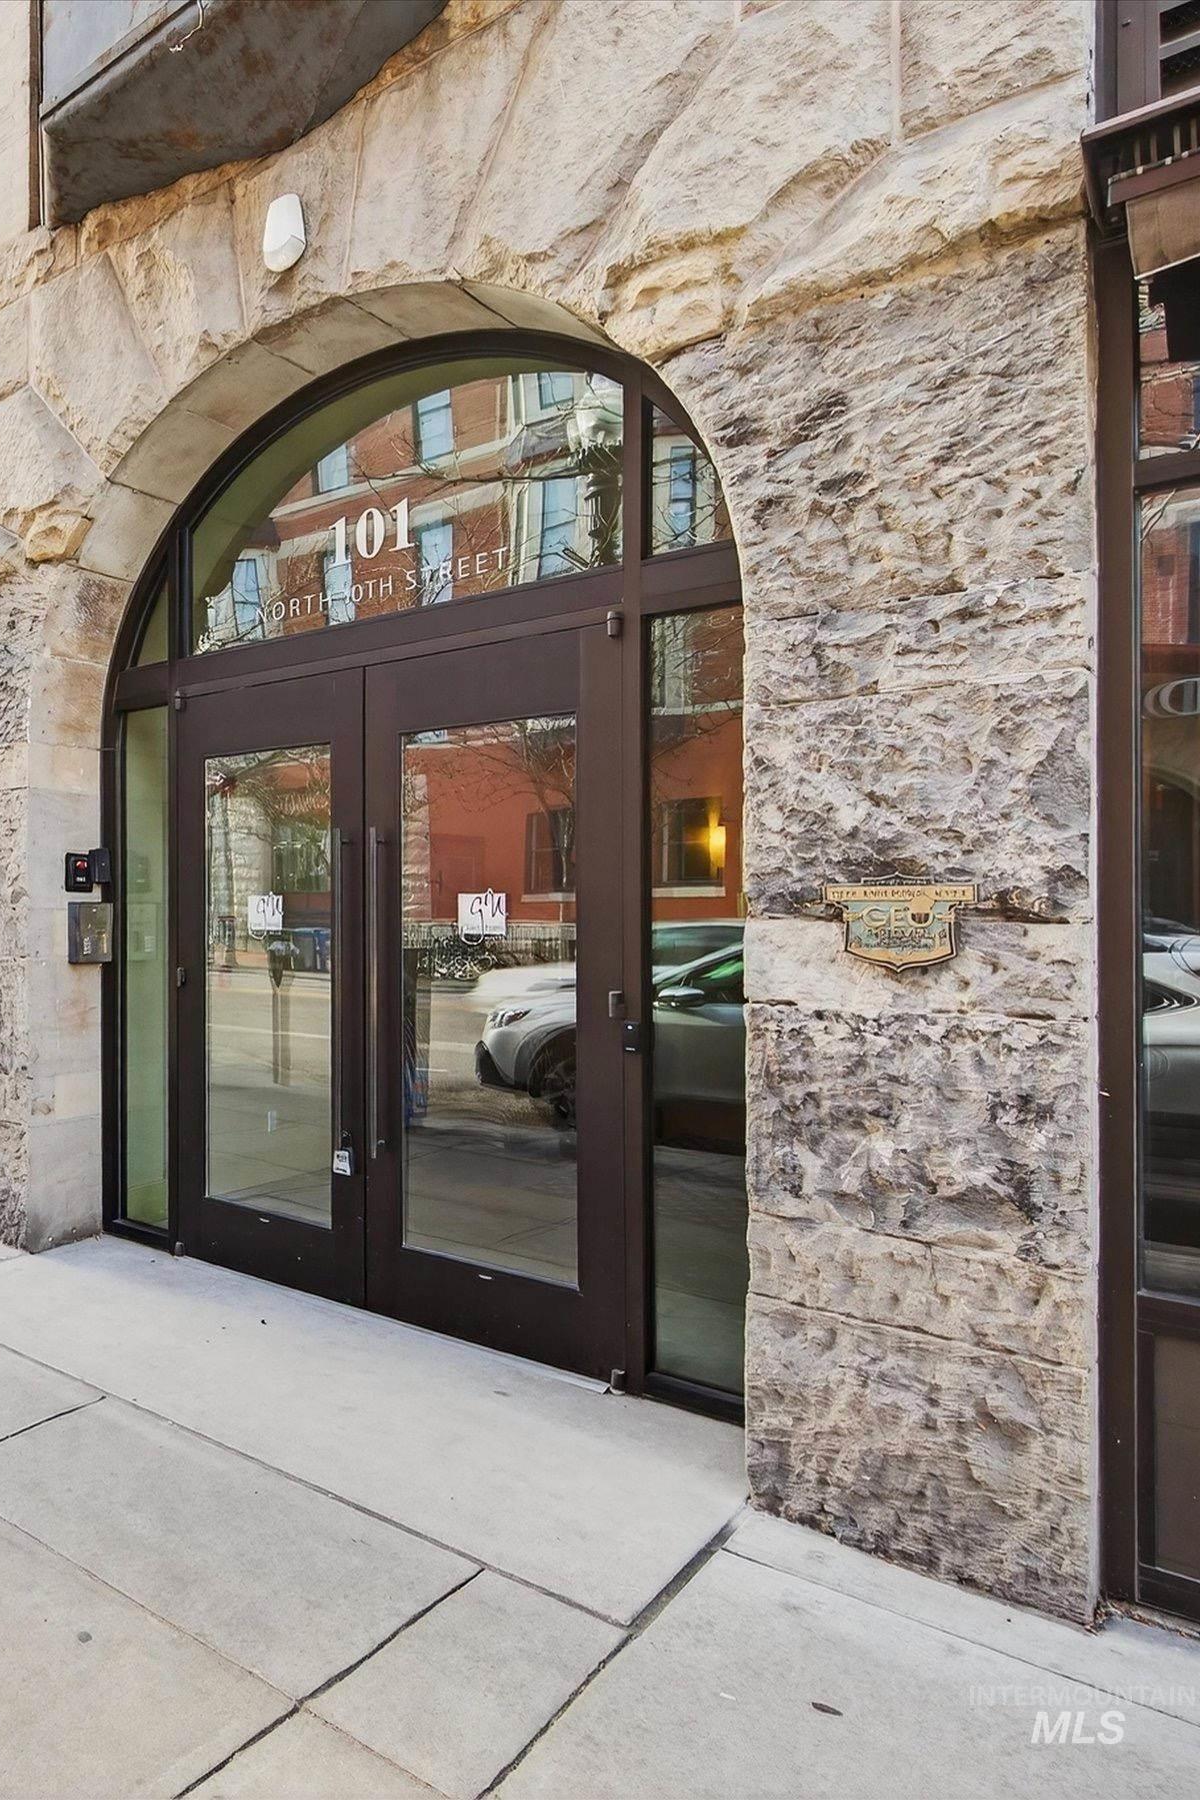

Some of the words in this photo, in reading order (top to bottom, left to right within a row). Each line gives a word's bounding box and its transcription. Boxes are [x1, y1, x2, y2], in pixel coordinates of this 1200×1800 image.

[329, 497, 417, 567] 101
[256, 592, 332, 623] NORTH
[345, 575, 393, 604] 0TH
